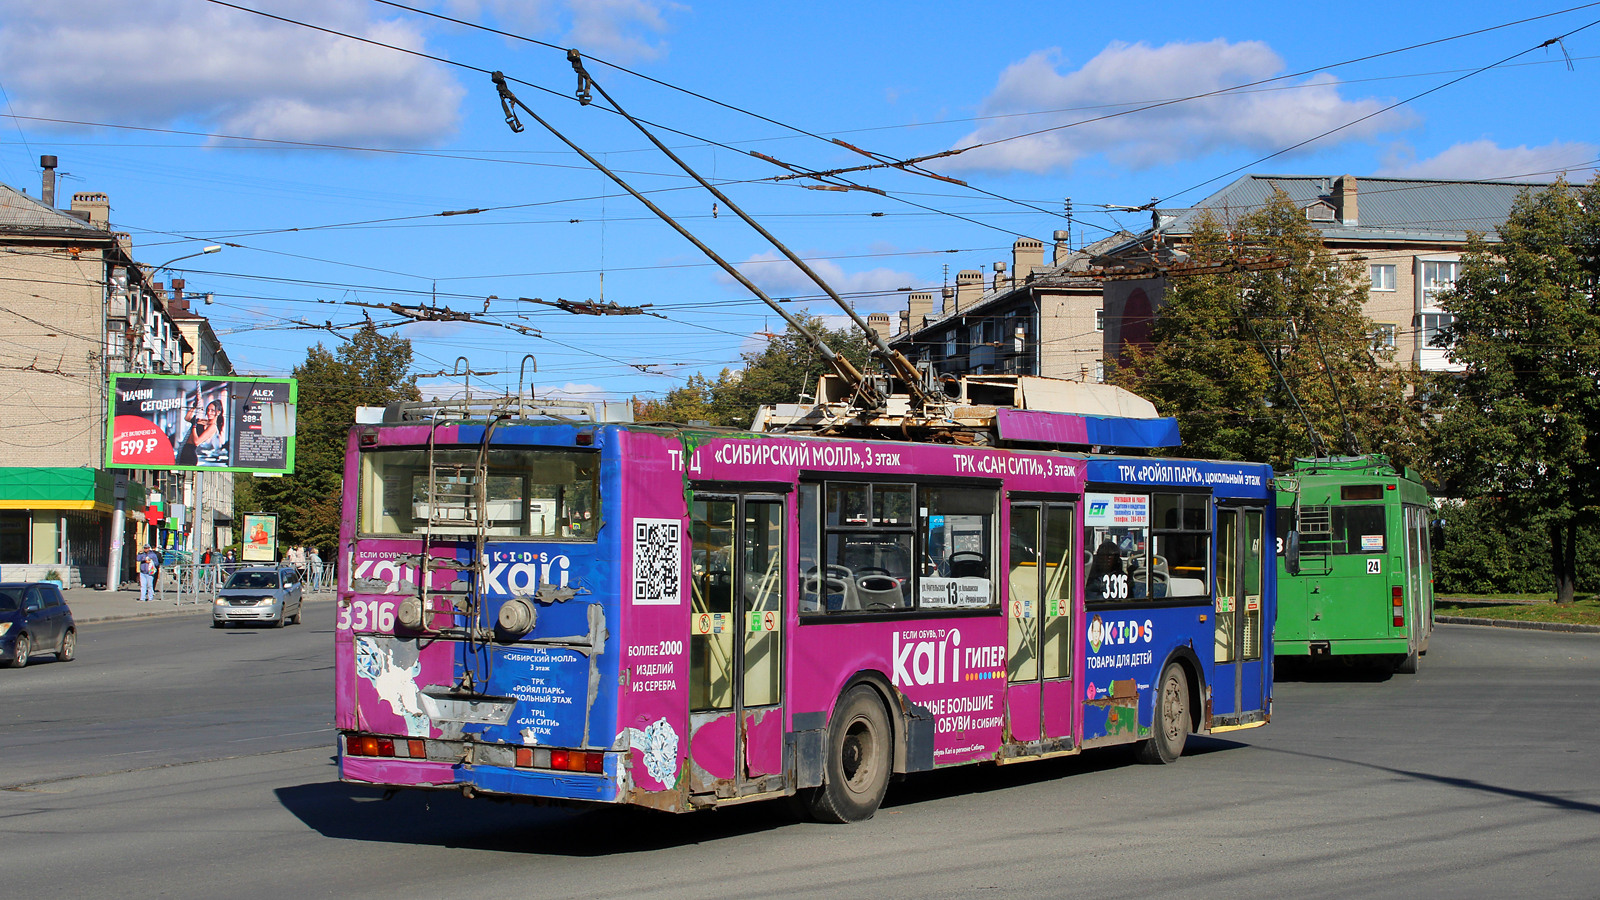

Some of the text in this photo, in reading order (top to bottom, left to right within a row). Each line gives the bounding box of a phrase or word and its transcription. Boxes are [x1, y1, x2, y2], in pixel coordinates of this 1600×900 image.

[123, 389, 153, 401] НАЧНИ
[252, 389, 274, 397] ALEX
[120, 439, 144, 456] 599
[714, 443, 809, 467] «СИБИРСКИЙ
[812, 446, 864, 469] МОЛЛ»,
[865, 447, 873, 466] 3
[874, 452, 901, 466] этаж
[953, 454, 1076, 478] ТРК «САН СИТИ», 3 этаж
[1118, 463, 1261, 486] ТРК «РОЙЯЛ ПАРК», цокольный этаж
[1368, 561, 1379, 572] 24
[946, 582, 958, 605] 13
[1102, 573, 1128, 599] 3316
[336, 600, 396, 632] 3316
[902, 630, 918, 639] ЕСЛИ
[938, 629, 946, 638] ТО
[628, 640, 683, 657] БОЛЛЕЕ 2000
[503, 653, 577, 663] «СИБИРСКИЙ МОЛЛ»
[892, 628, 961, 687] kari
[965, 646, 1005, 669] ГИПЕР
[1087, 650, 1152, 669] ТОВАРЫ ДЛЯ ДЕТЕЙ
[636, 661, 674, 676] ИЗДЕЛИЙ
[512, 684, 565, 694] «РОЙЯЛ ПАРК»
[632, 679, 677, 692] ИЗ СЕРЕБРА
[552, 696, 572, 704] ЭТАЖ
[947, 694, 994, 715] БОЛЬШИЕ
[531, 709, 545, 717] ТРЦ
[516, 717, 560, 727] «САН СИТИ»
[938, 715, 971, 734] ОБУВИ
